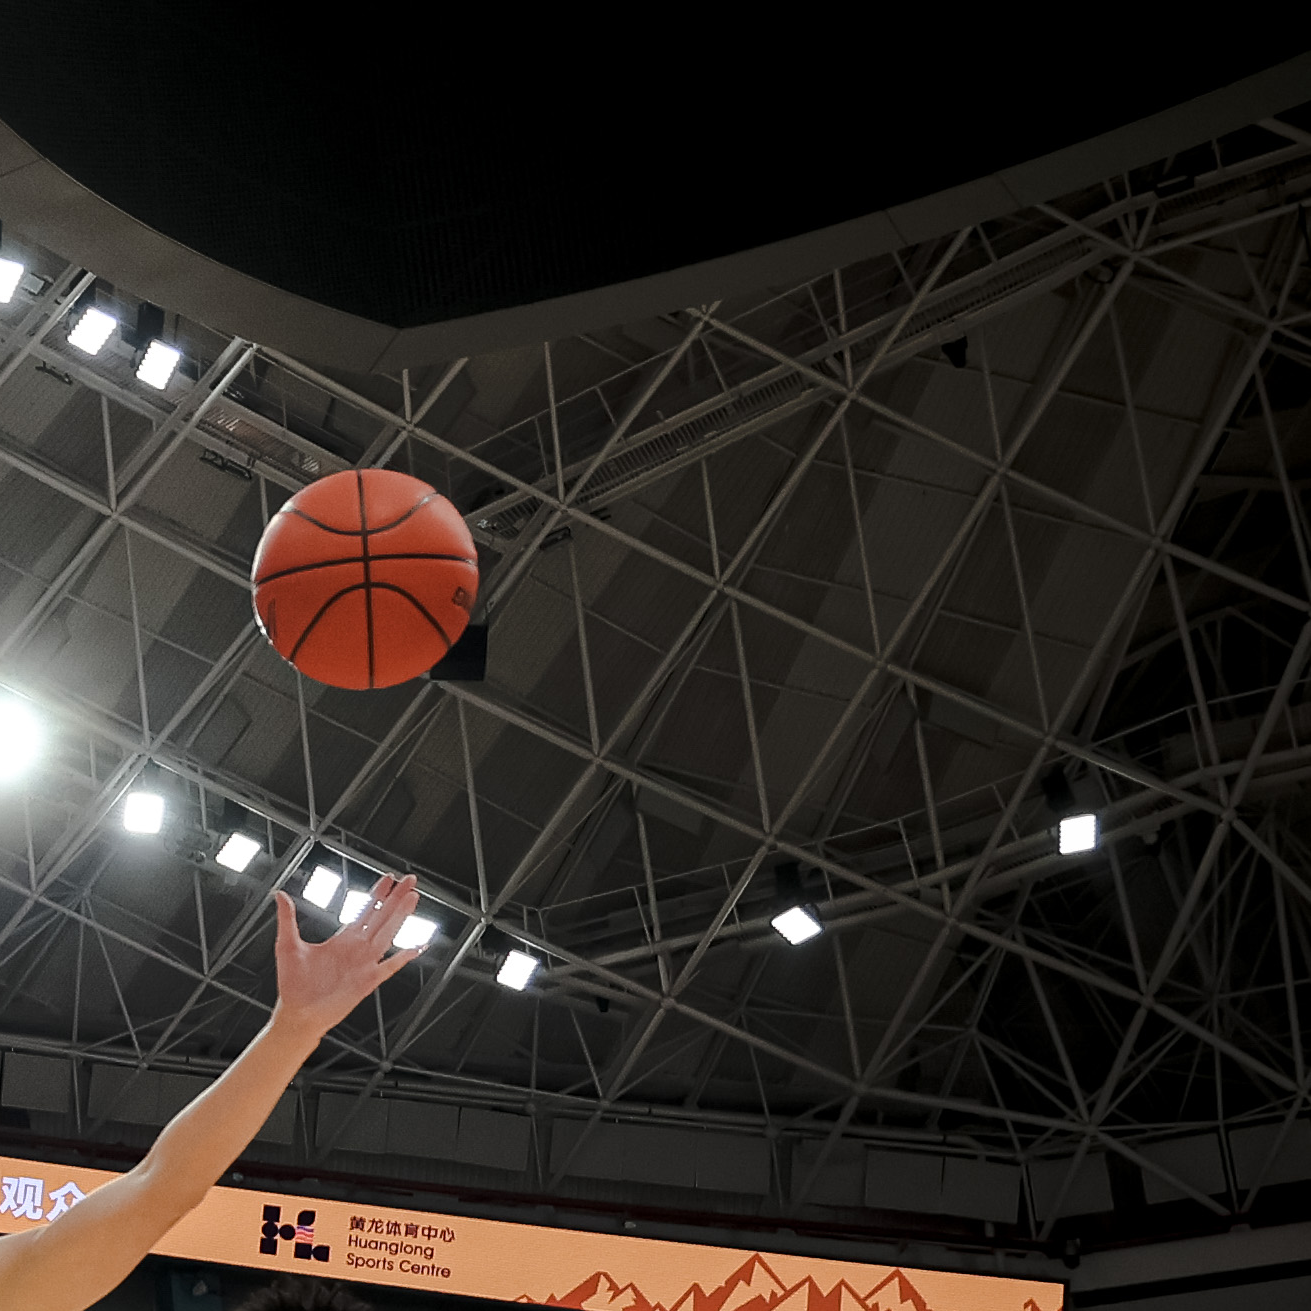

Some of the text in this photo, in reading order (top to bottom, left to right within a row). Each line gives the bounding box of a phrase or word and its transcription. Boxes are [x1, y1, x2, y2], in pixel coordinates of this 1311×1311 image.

[349, 1215, 456, 1243] 黄龙体育中心
[348, 1234, 435, 1260] Huanglong
[345, 1252, 452, 1279] Sports Centre
